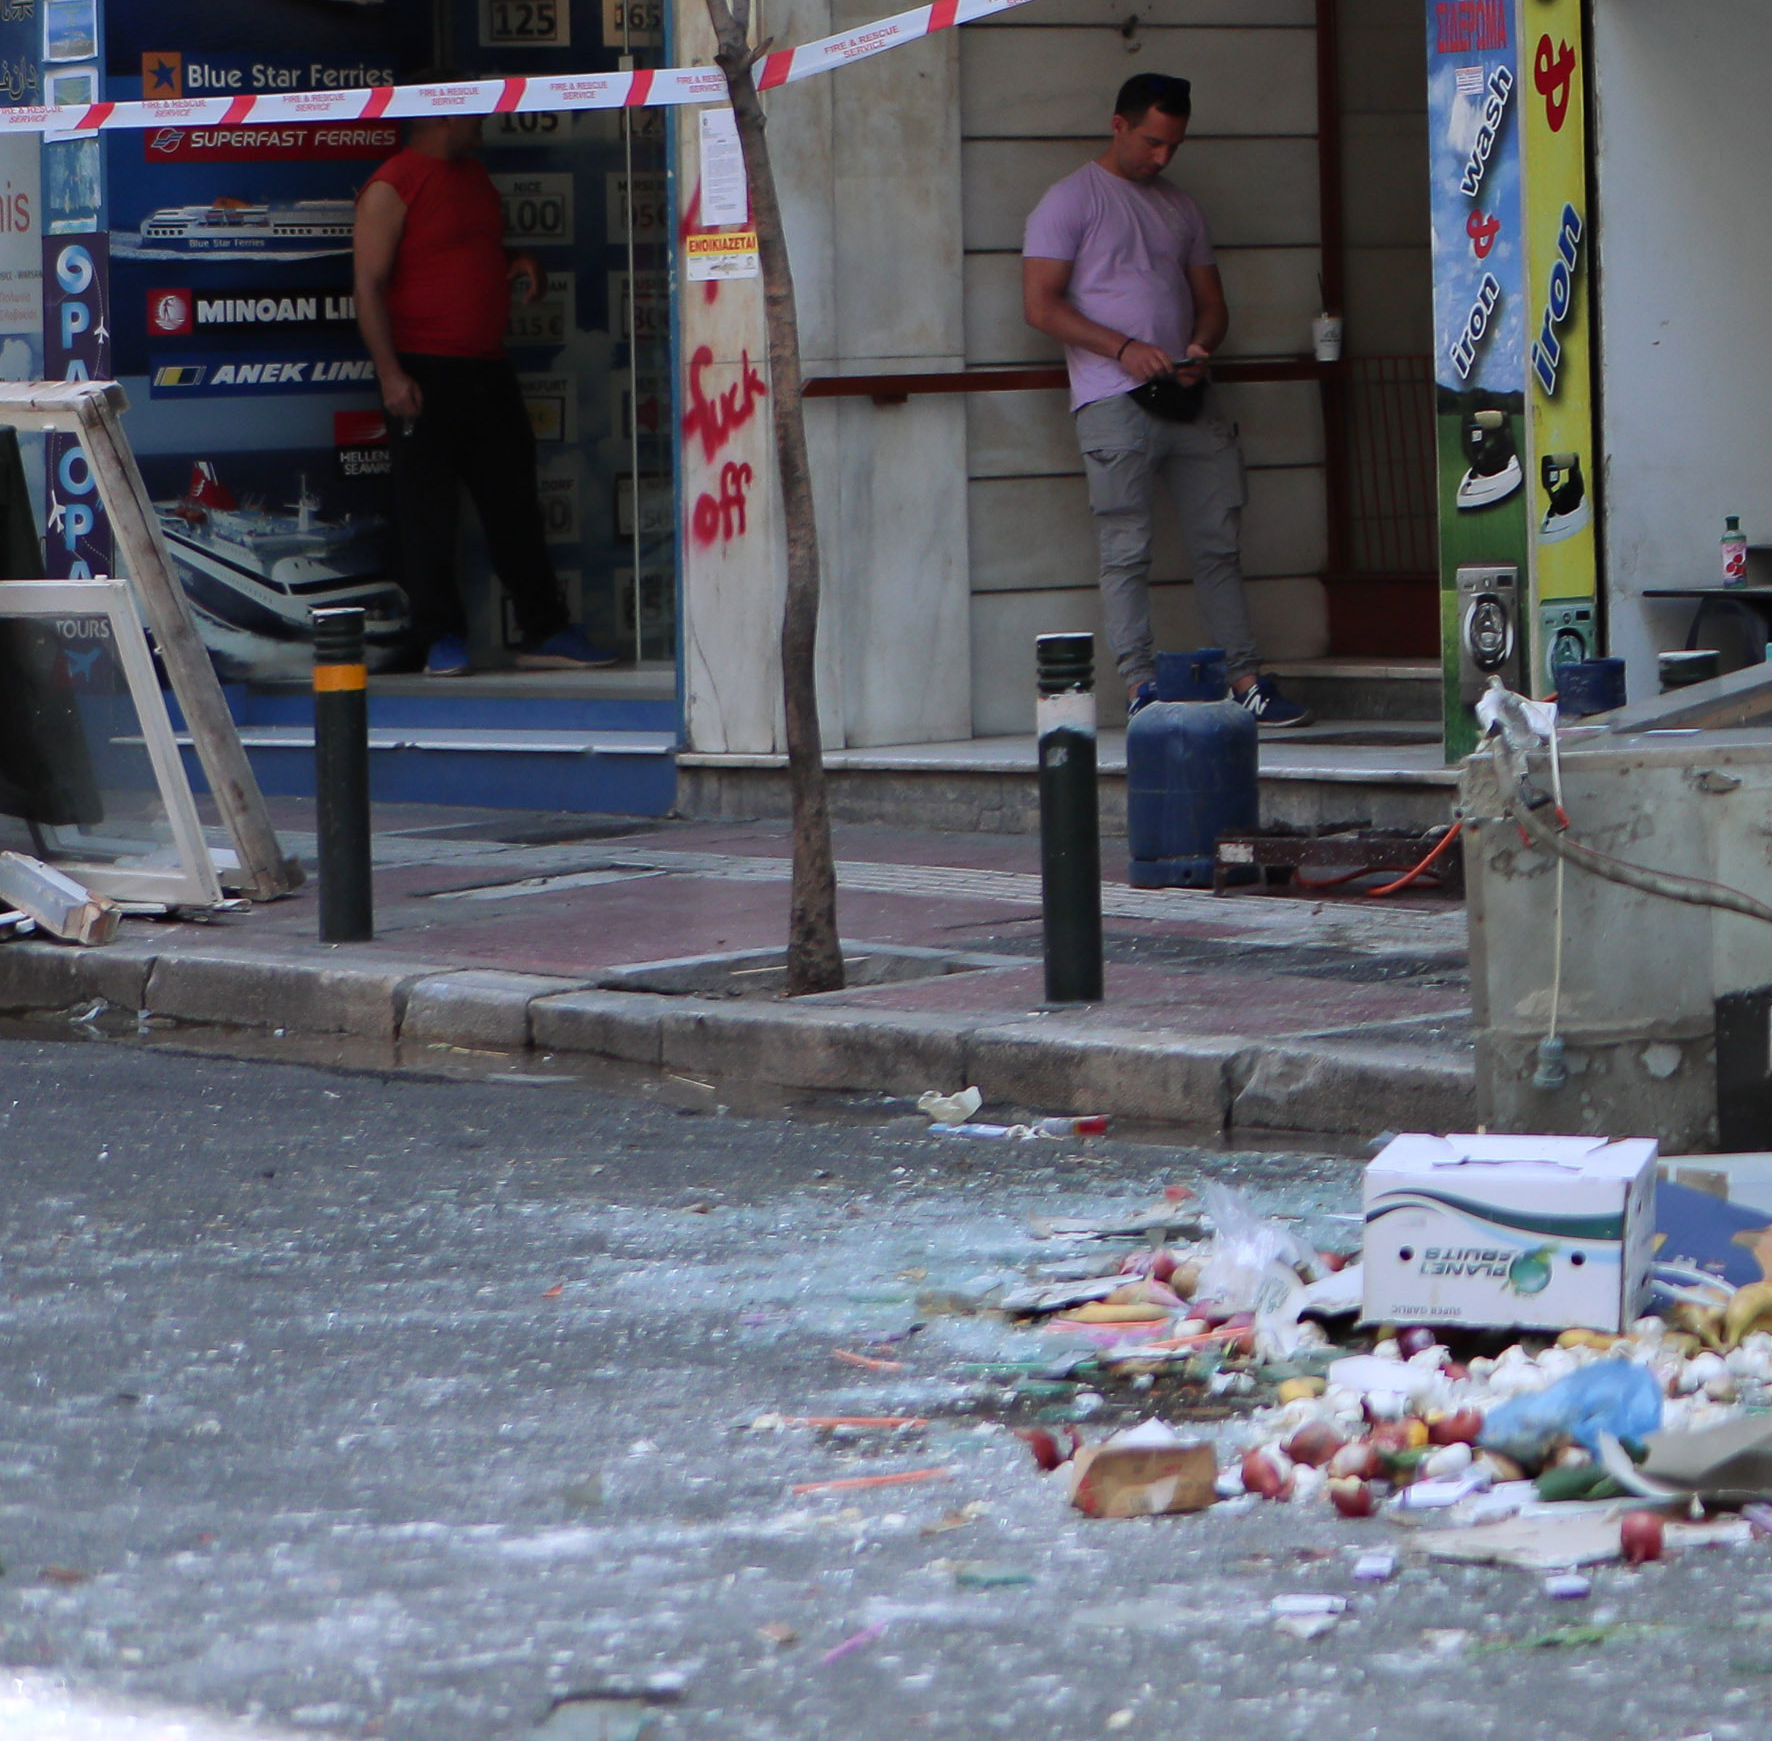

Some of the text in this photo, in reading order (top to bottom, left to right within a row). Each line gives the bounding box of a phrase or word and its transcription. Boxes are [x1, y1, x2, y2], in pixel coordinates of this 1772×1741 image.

[494, 2, 556, 37] 125
[823, 41, 847, 55] FIRE
[858, 24, 900, 45] RESCUE
[842, 39, 886, 59] SERVICE
[187, 62, 395, 88] Blue Star Ferries
[190, 129, 396, 148] SUPERFAST FERRIES
[1460, 64, 1514, 198] wash
[513, 181, 543, 194] NICE
[197, 297, 318, 324] MINOAN
[1530, 201, 1583, 395] iron
[1449, 271, 1501, 379] iron
[210, 361, 377, 385] ANEK LINE
[692, 461, 753, 549] off
